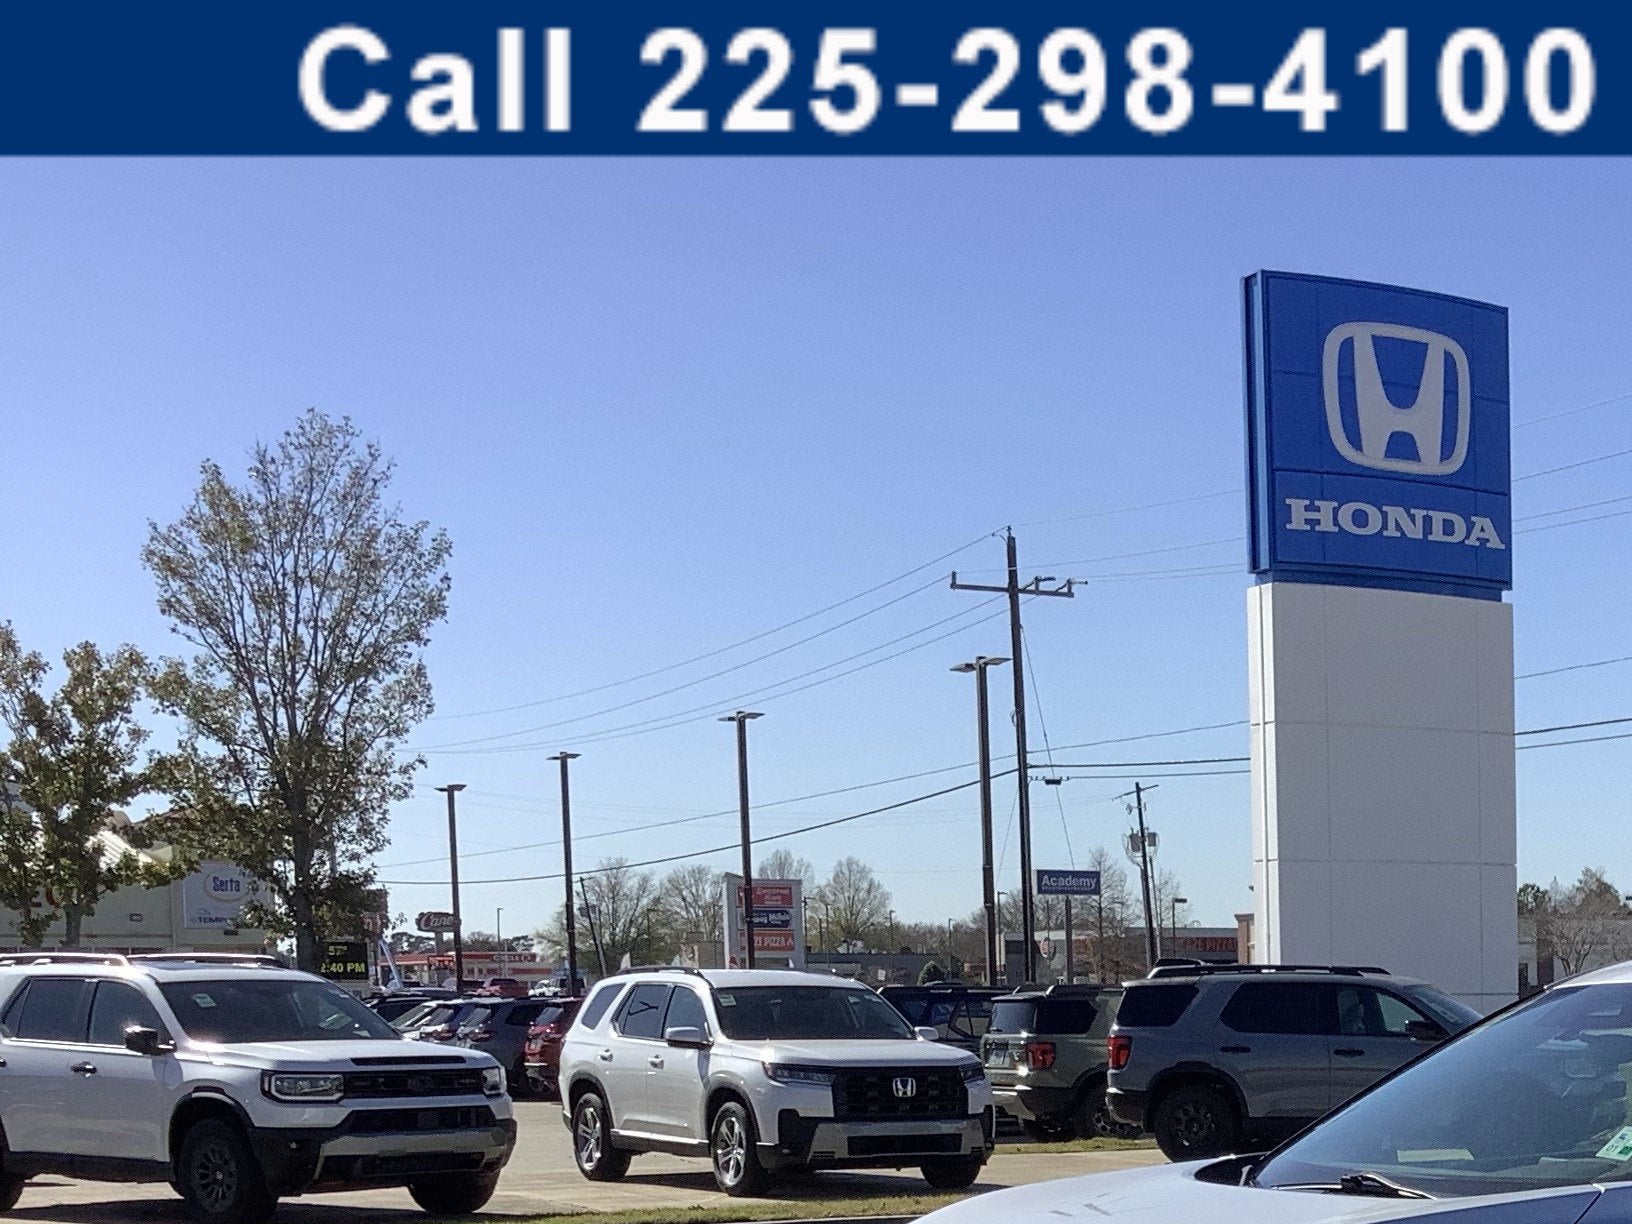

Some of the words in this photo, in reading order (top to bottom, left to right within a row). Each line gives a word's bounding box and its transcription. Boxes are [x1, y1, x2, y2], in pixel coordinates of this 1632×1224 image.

[1285, 498, 1505, 550] HONDA
[212, 876, 241, 892] Serta
[1042, 875, 1097, 890] Academy
[347, 962, 366, 972] PM
